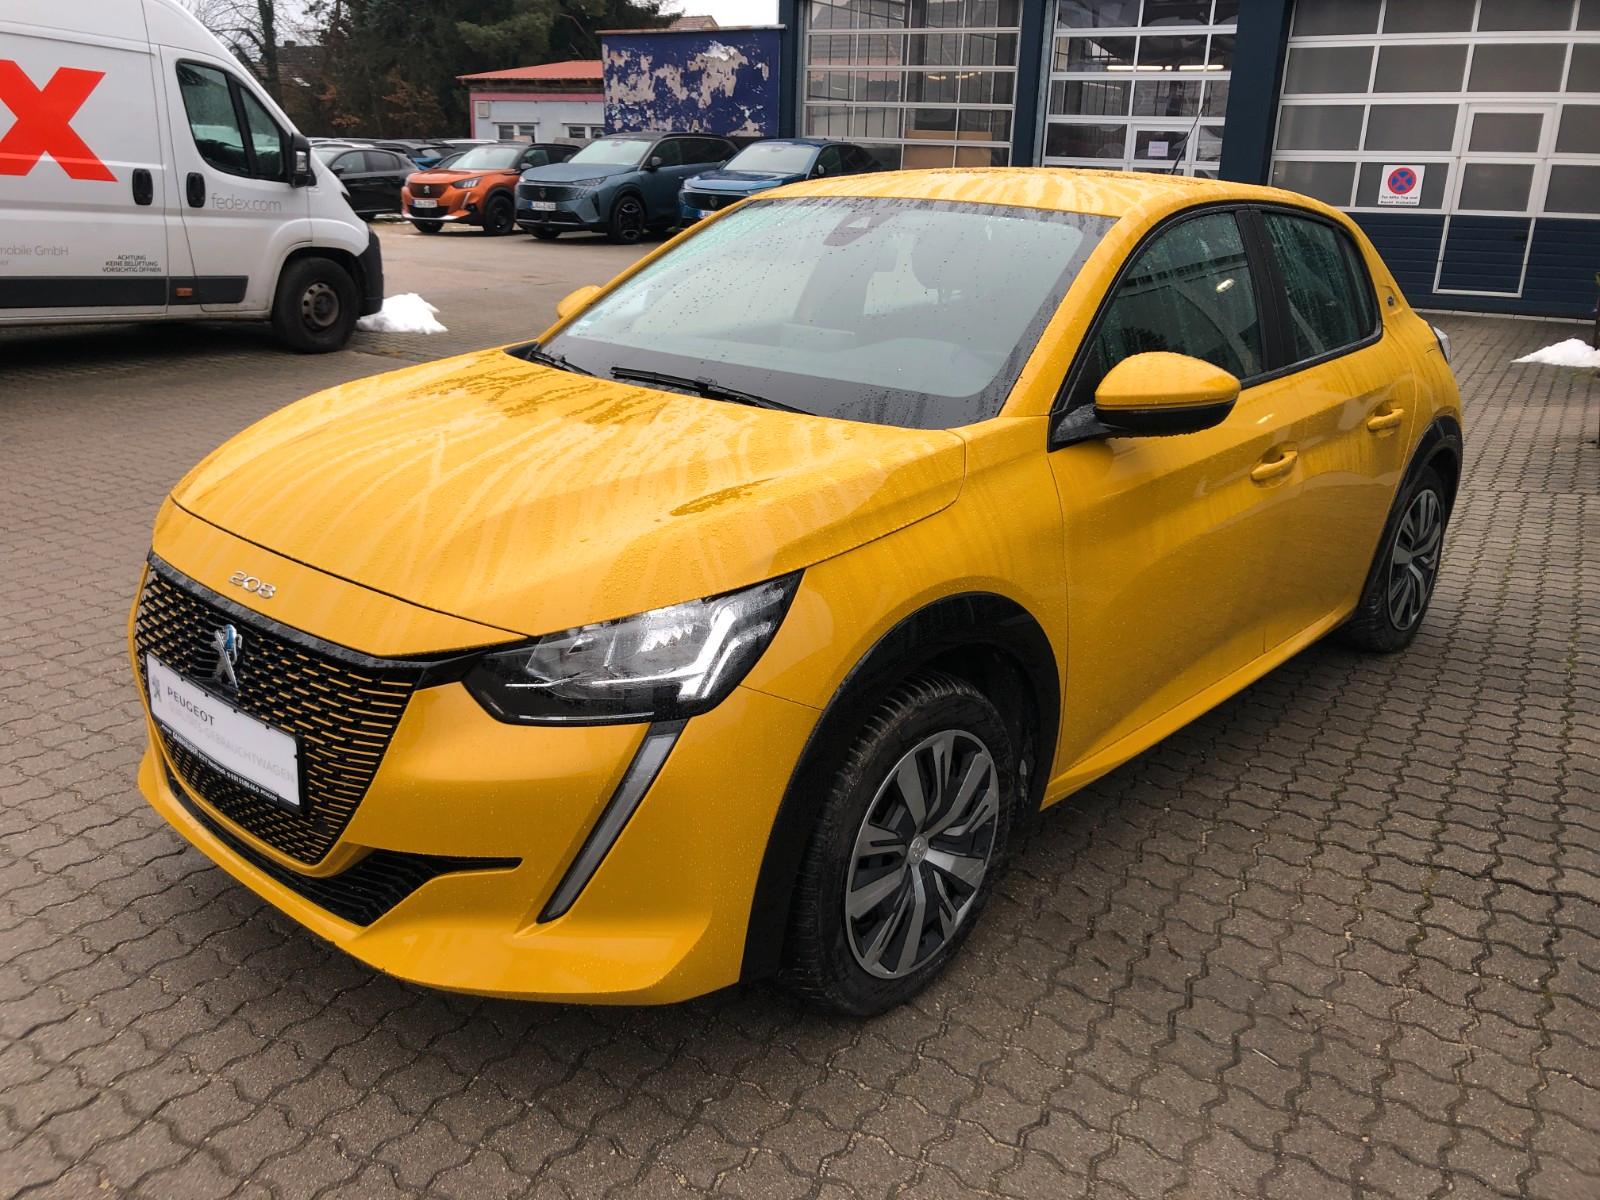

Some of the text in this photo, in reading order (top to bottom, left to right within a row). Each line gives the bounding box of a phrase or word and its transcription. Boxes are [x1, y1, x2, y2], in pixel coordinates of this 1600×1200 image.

[211, 193, 282, 212] fedex.com
[34, 245, 69, 257] GmbH
[229, 570, 276, 599] 208
[167, 686, 216, 726] PEUGEOT
